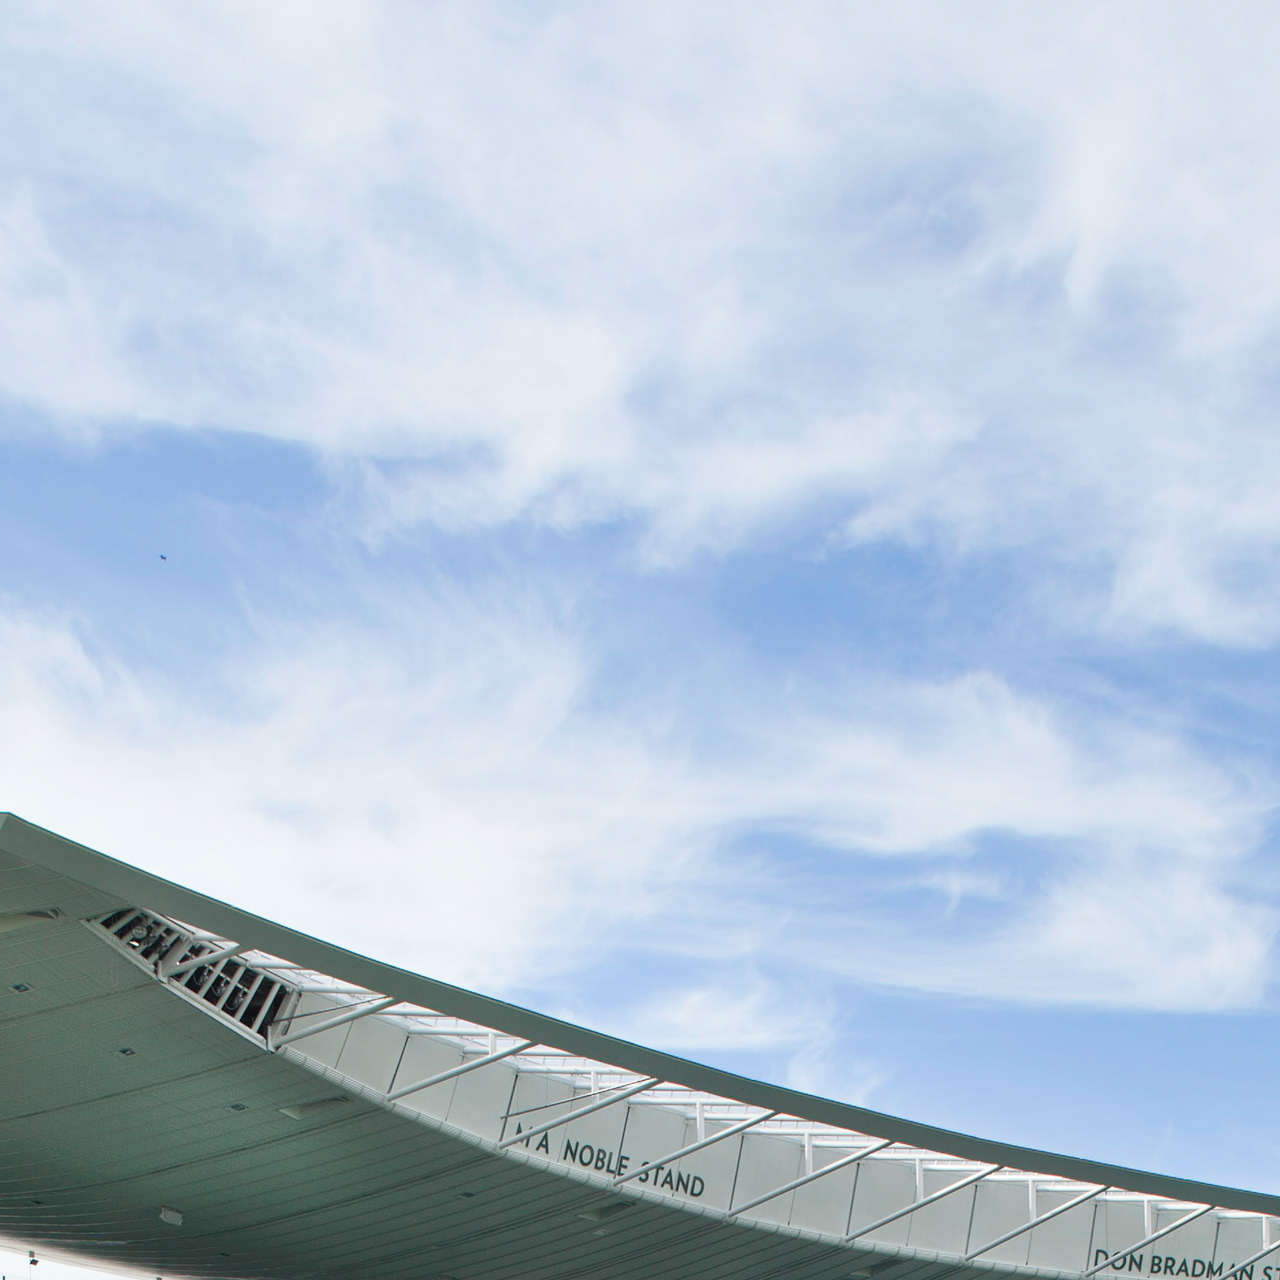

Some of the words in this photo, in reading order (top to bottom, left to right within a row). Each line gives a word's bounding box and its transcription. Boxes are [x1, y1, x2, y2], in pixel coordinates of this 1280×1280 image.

[536, 1131, 549, 1155] A
[563, 1138, 630, 1176] NOBLE
[638, 1161, 705, 1197] STAND
[1094, 1249, 1143, 1273] DON
